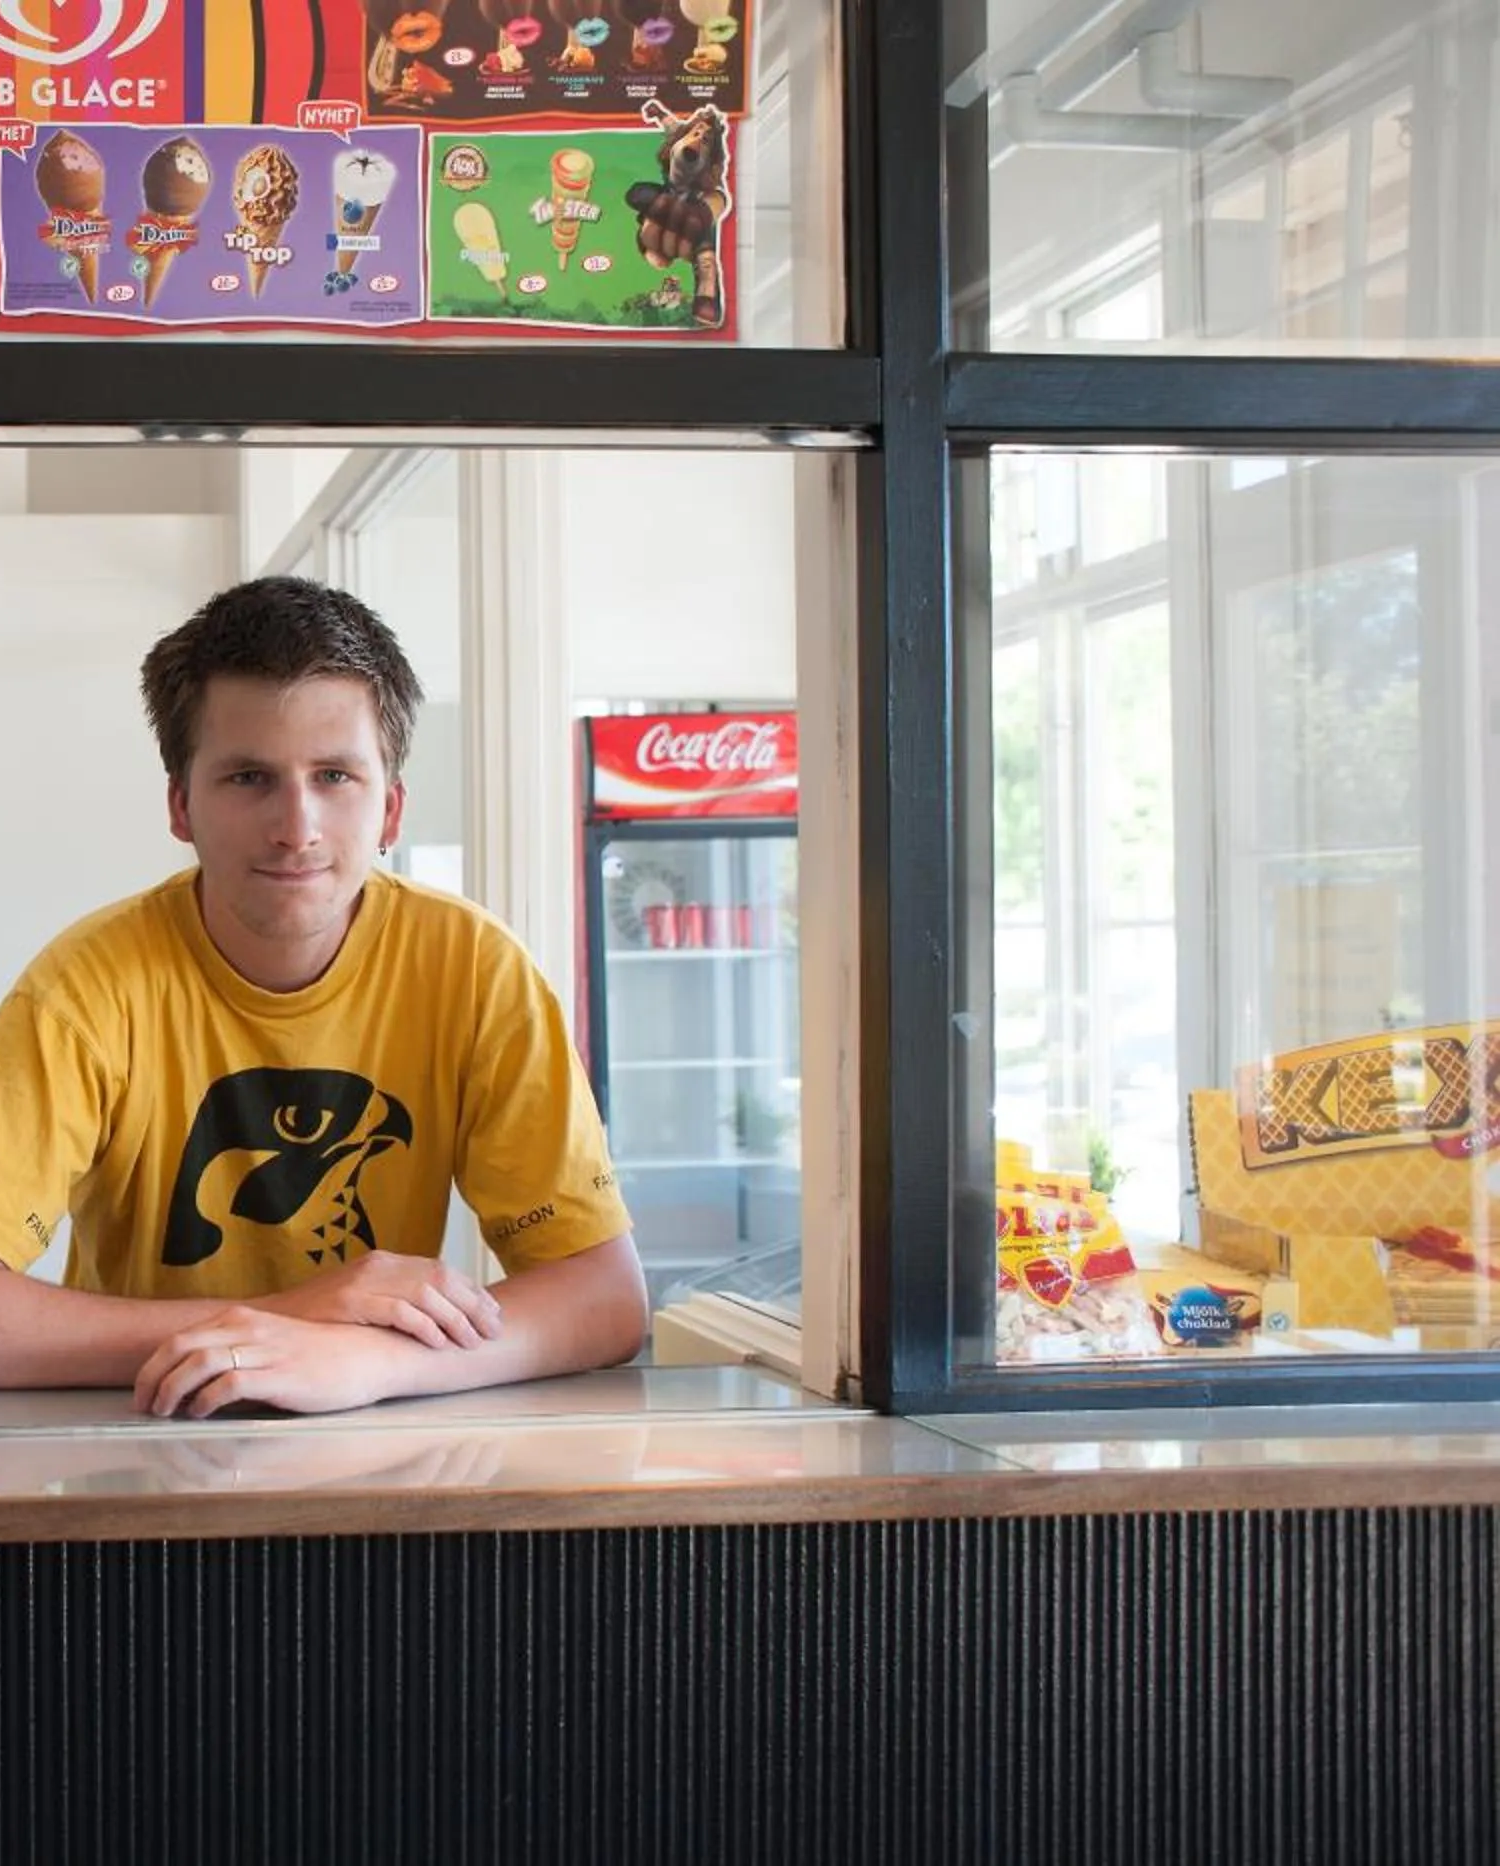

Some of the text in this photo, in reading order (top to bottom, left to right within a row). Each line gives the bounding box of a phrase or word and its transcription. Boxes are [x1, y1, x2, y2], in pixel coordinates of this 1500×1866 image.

[31, 77, 156, 107] GLACE
[304, 107, 356, 125] NYHET
[52, 215, 102, 237] Daim
[138, 223, 189, 245] Daim
